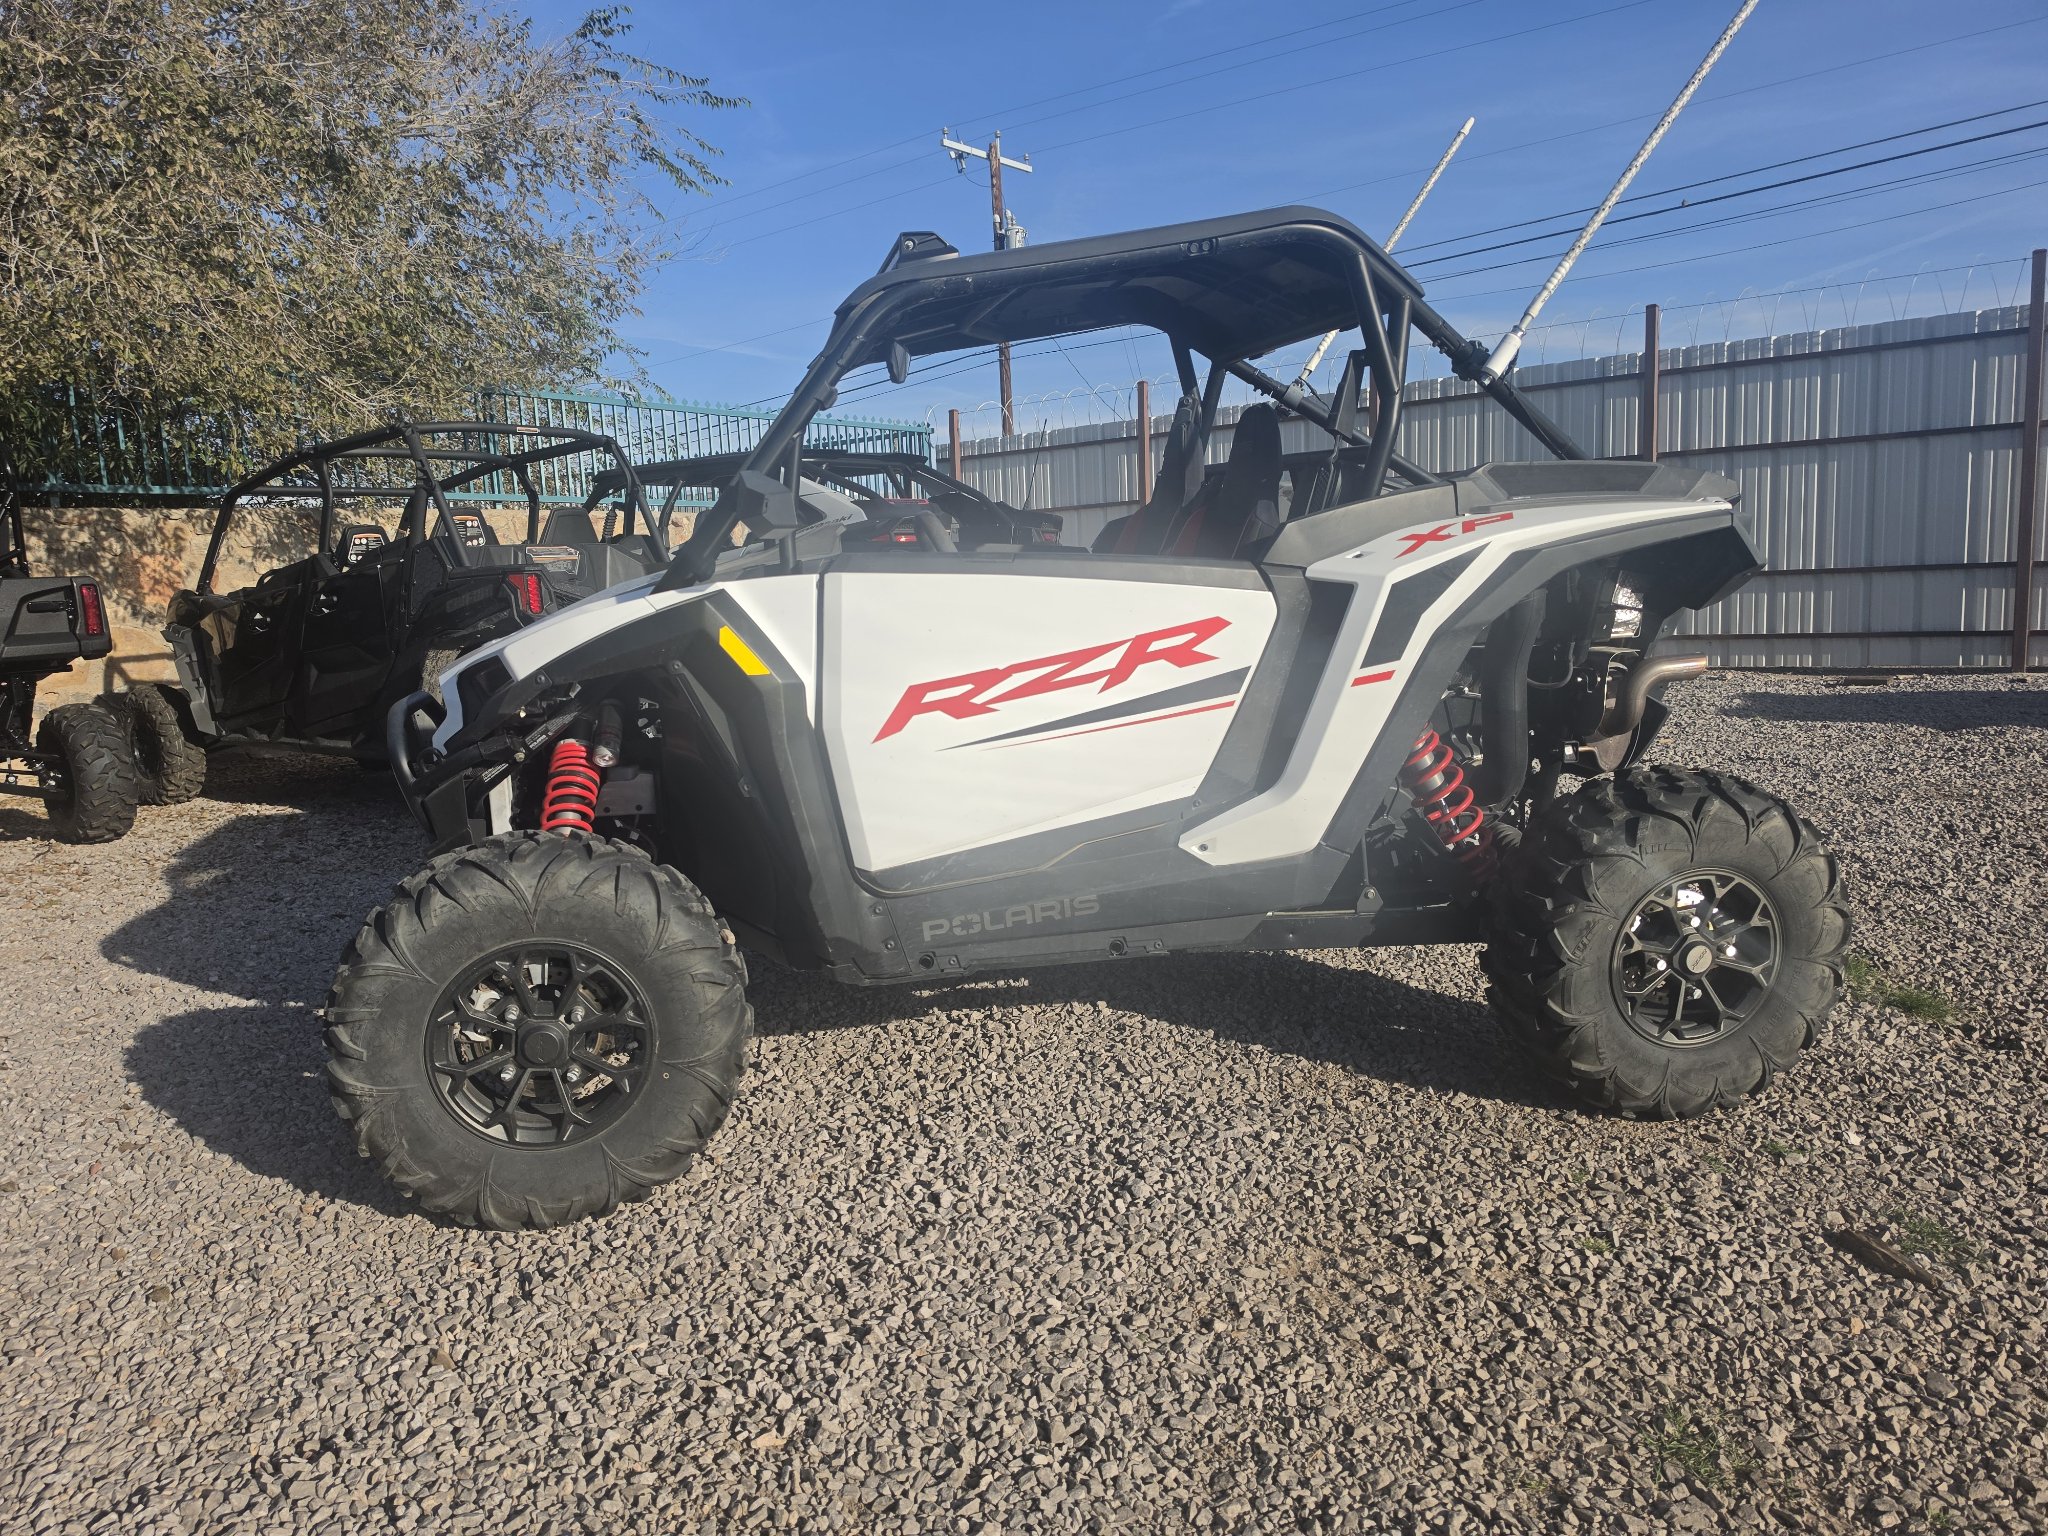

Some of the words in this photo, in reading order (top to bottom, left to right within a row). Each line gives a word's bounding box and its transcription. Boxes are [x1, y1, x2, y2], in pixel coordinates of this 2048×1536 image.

[1393, 512, 1515, 560] XP
[871, 616, 1233, 744] RZR
[922, 895, 1100, 941] POLARIS
